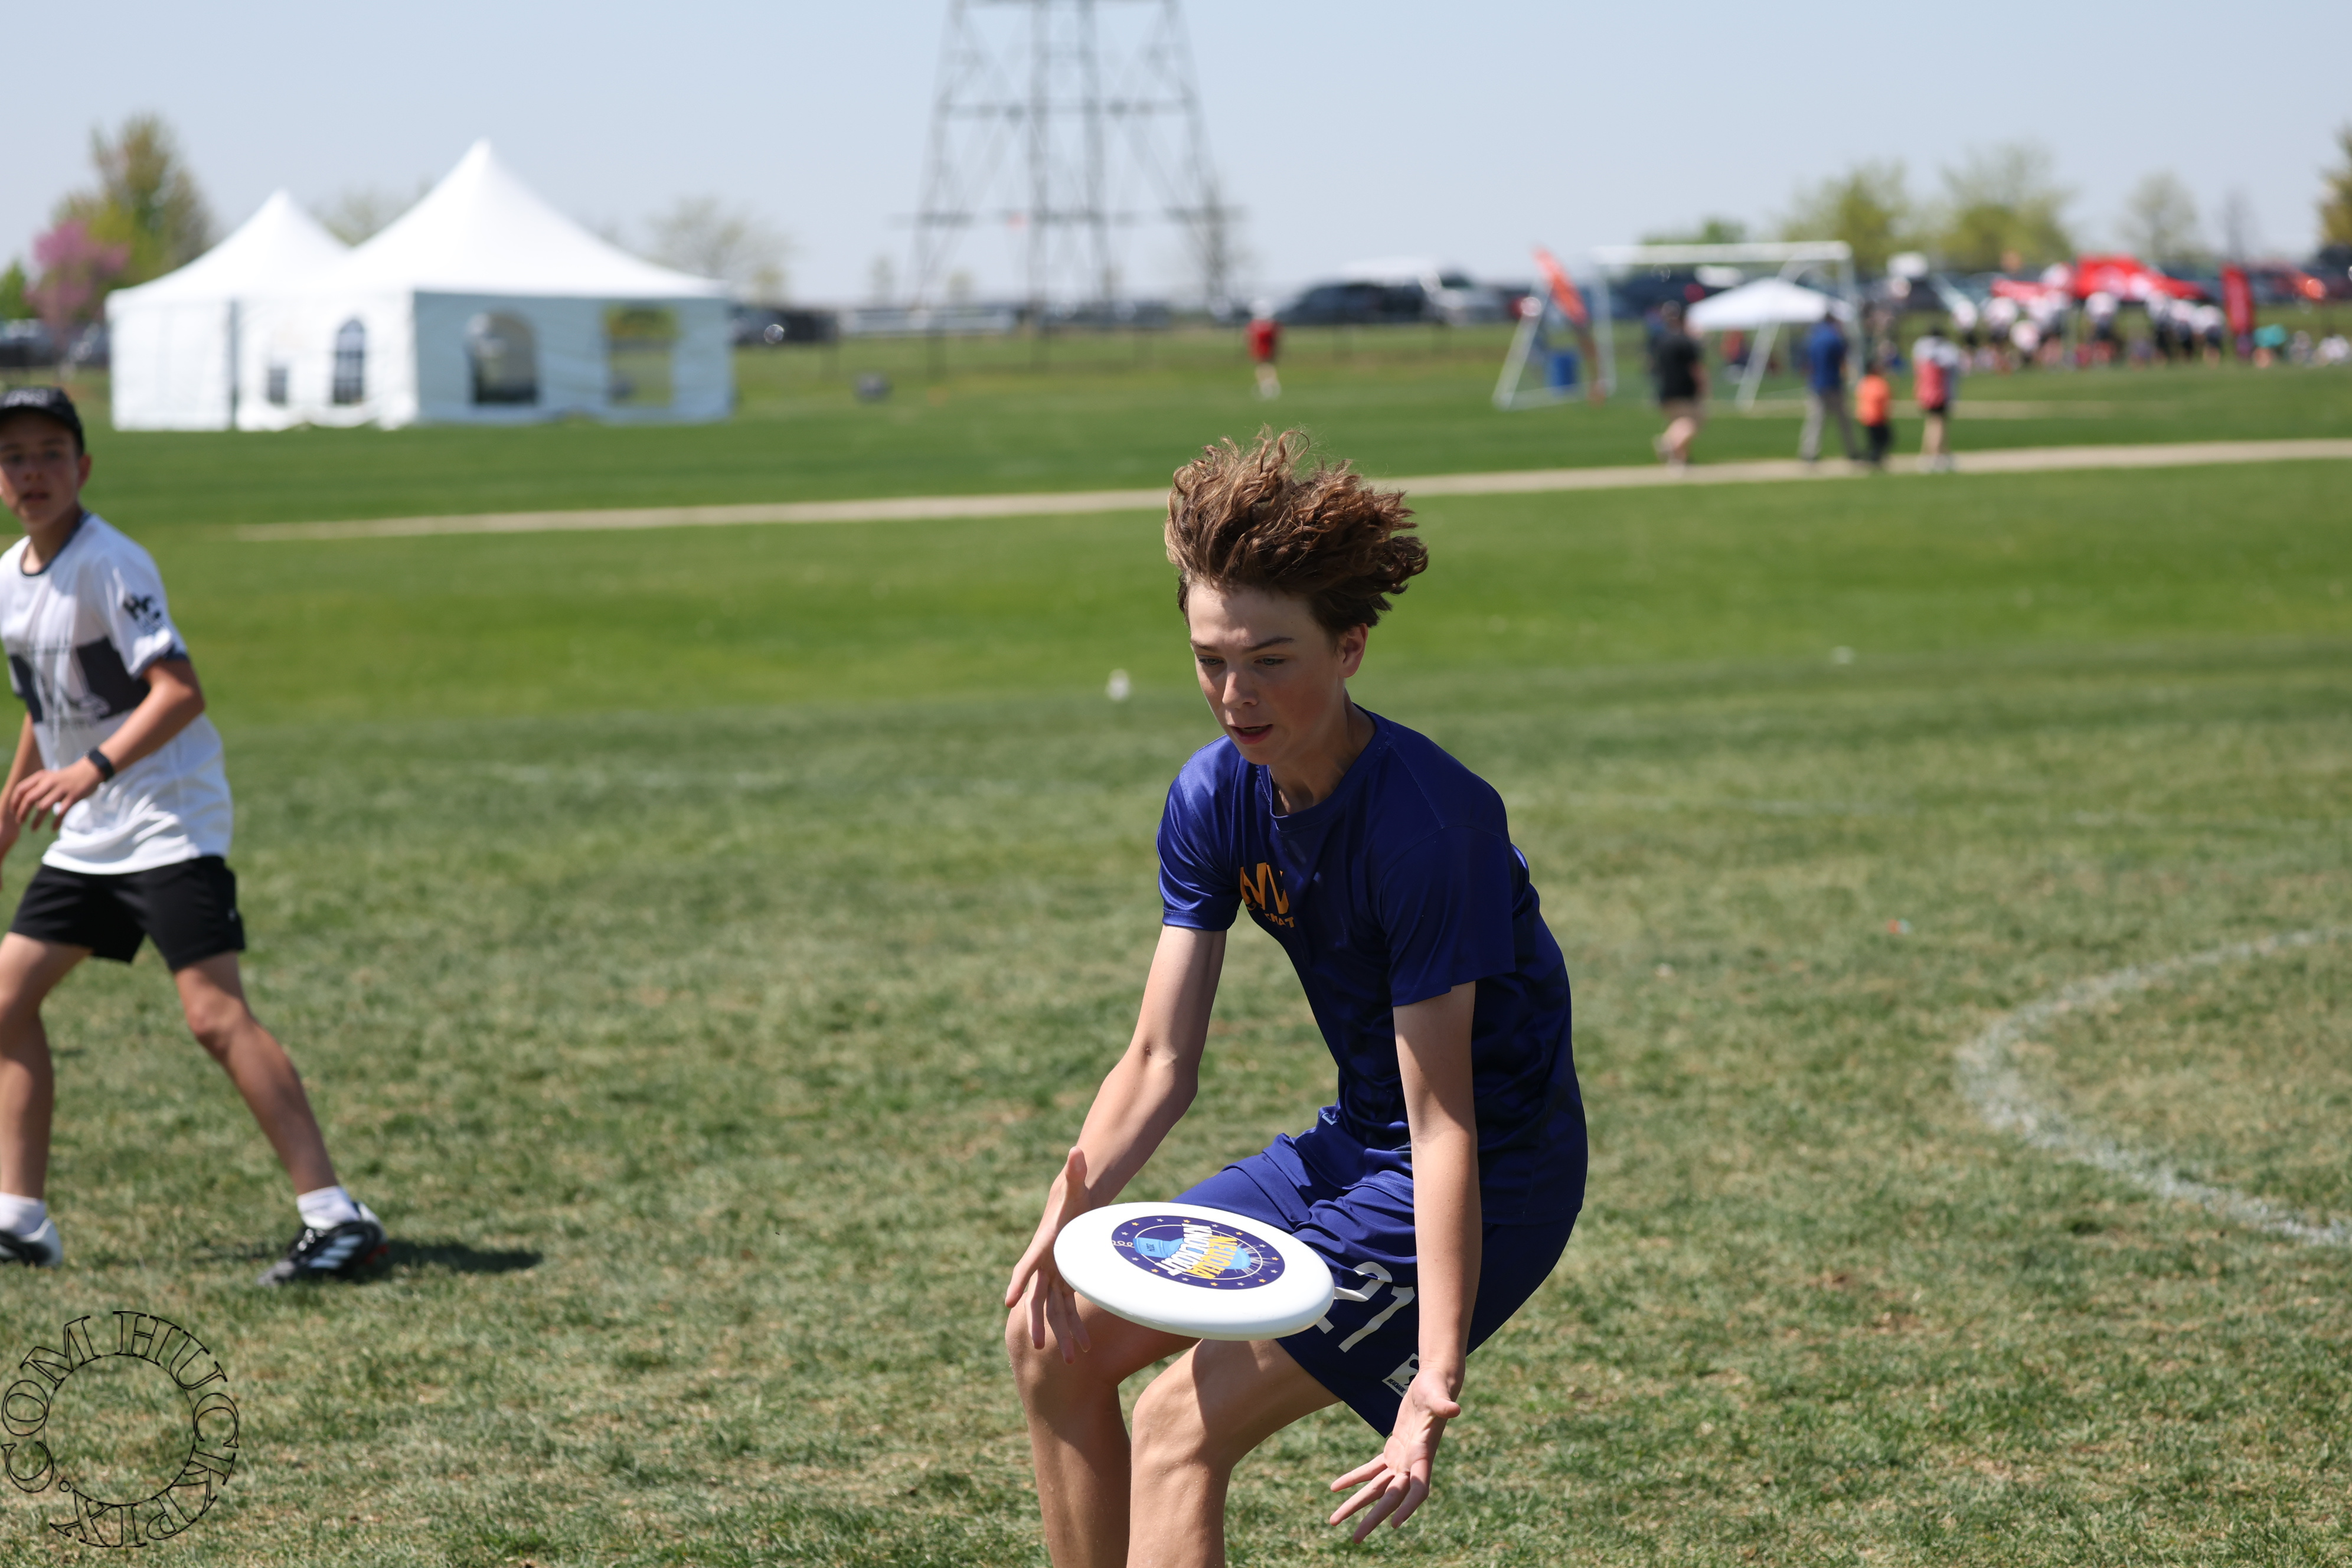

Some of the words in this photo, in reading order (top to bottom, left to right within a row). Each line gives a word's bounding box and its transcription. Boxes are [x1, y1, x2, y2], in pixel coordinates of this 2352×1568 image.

[1155, 1223, 1213, 1276] KNOCKOUT
[1185, 1235, 1238, 1279] NEUQUA
[1316, 1261, 1416, 1353] 21
